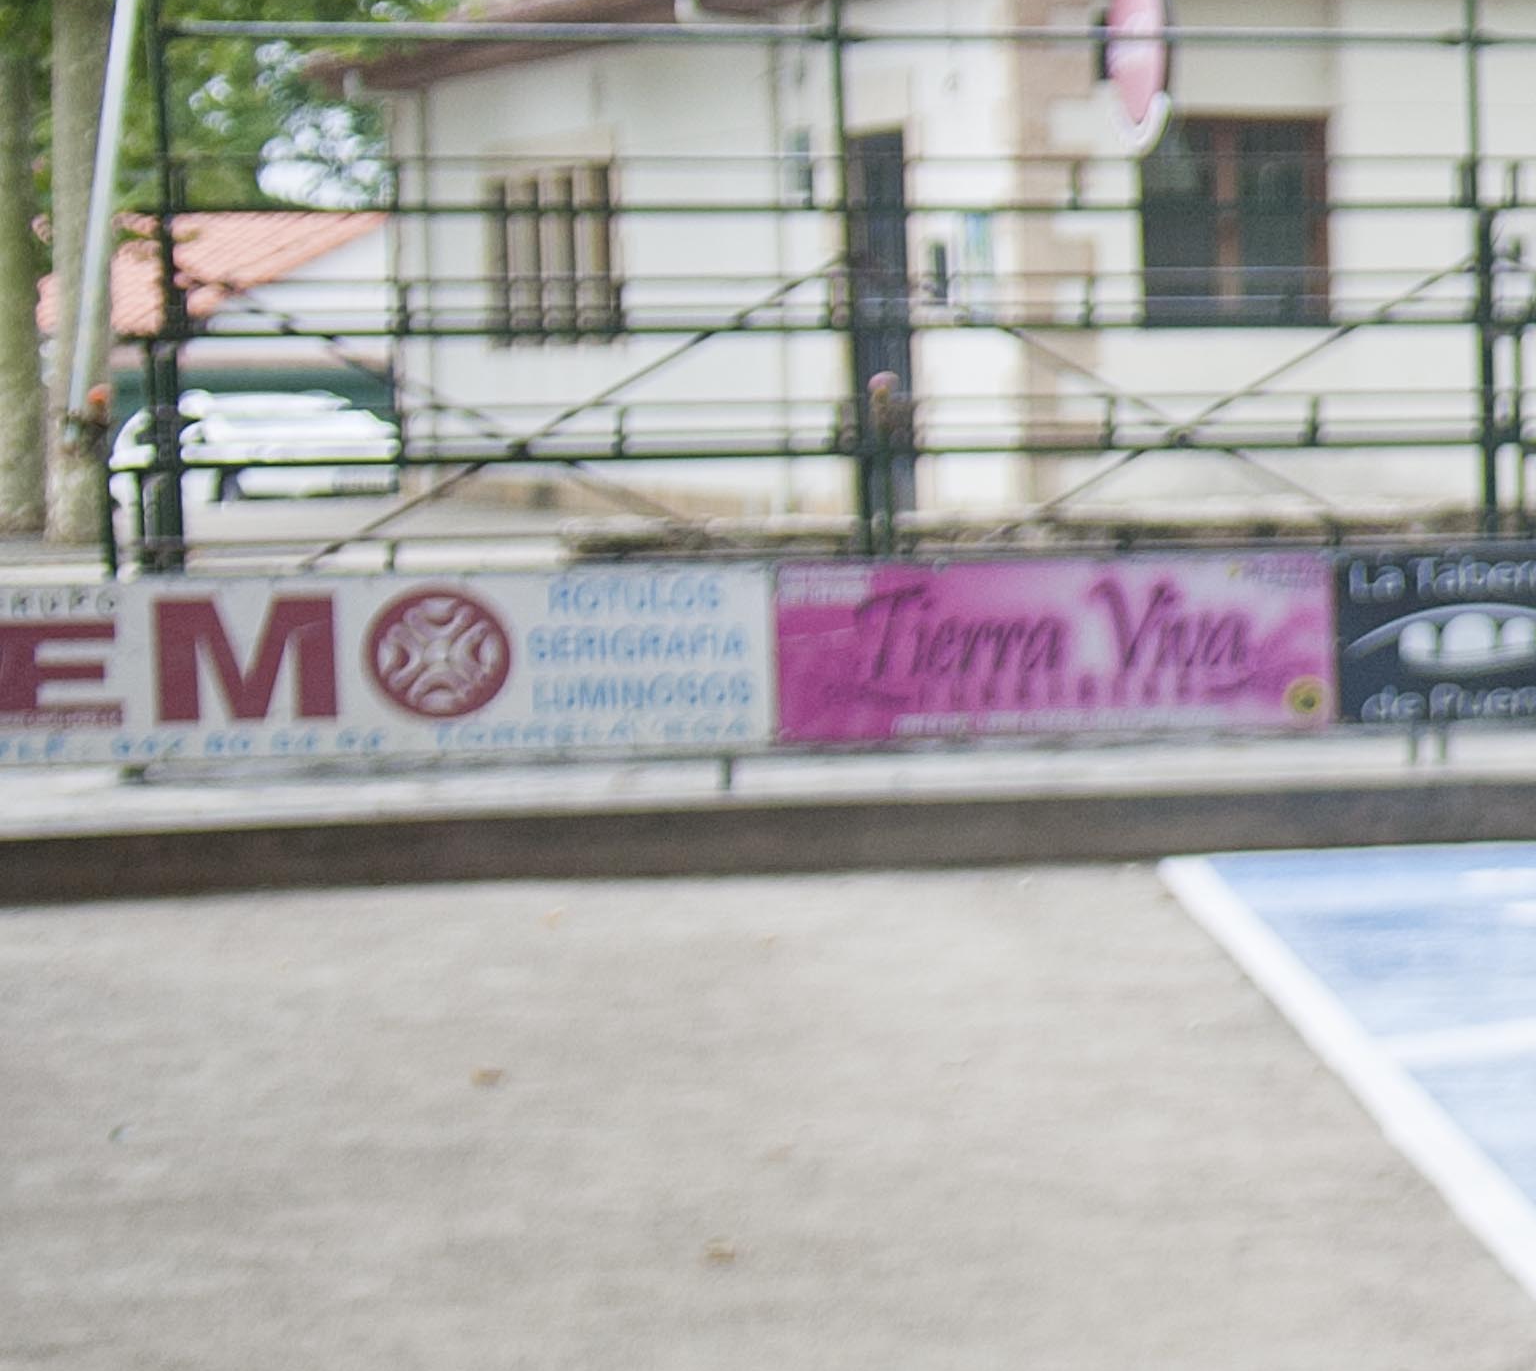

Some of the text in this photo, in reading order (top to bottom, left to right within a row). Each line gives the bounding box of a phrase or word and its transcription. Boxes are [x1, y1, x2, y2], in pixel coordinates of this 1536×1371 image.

[1348, 559, 1406, 603] La
[853, 582, 1065, 682] Tierra
[1088, 578, 1248, 672] Viva
[1361, 684, 1428, 722] de
